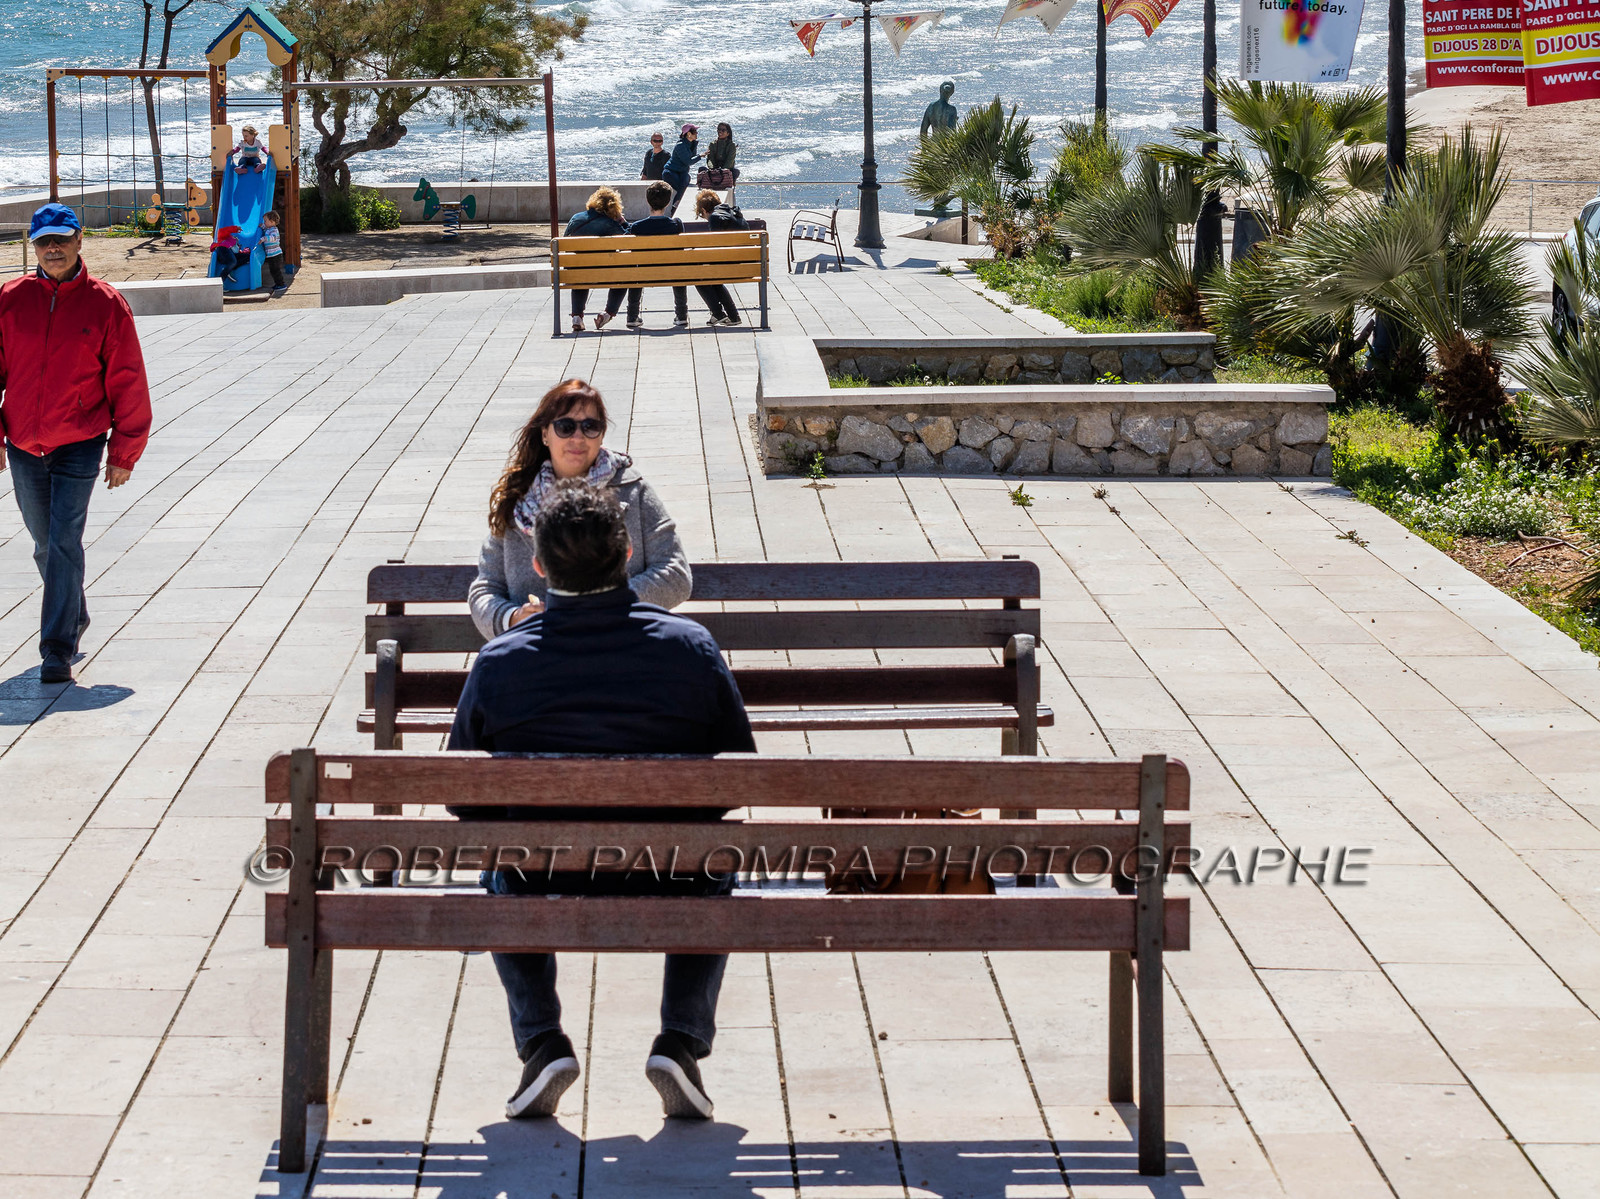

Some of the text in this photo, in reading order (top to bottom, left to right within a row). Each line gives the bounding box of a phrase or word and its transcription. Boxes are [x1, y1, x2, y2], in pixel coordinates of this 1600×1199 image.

[1258, 0, 1348, 16] future, today.
[1425, 9, 1459, 23] SANT
[1462, 7, 1494, 20] PERE
[1497, 7, 1513, 19] DE
[1526, 15, 1554, 26] PARC
[1587, 10, 1600, 19] LA
[1433, 39, 1479, 54] DIJOUS
[1481, 38, 1498, 51] 28
[1535, 31, 1600, 57] DIJOUS
[1437, 63, 1525, 75] www.conforam
